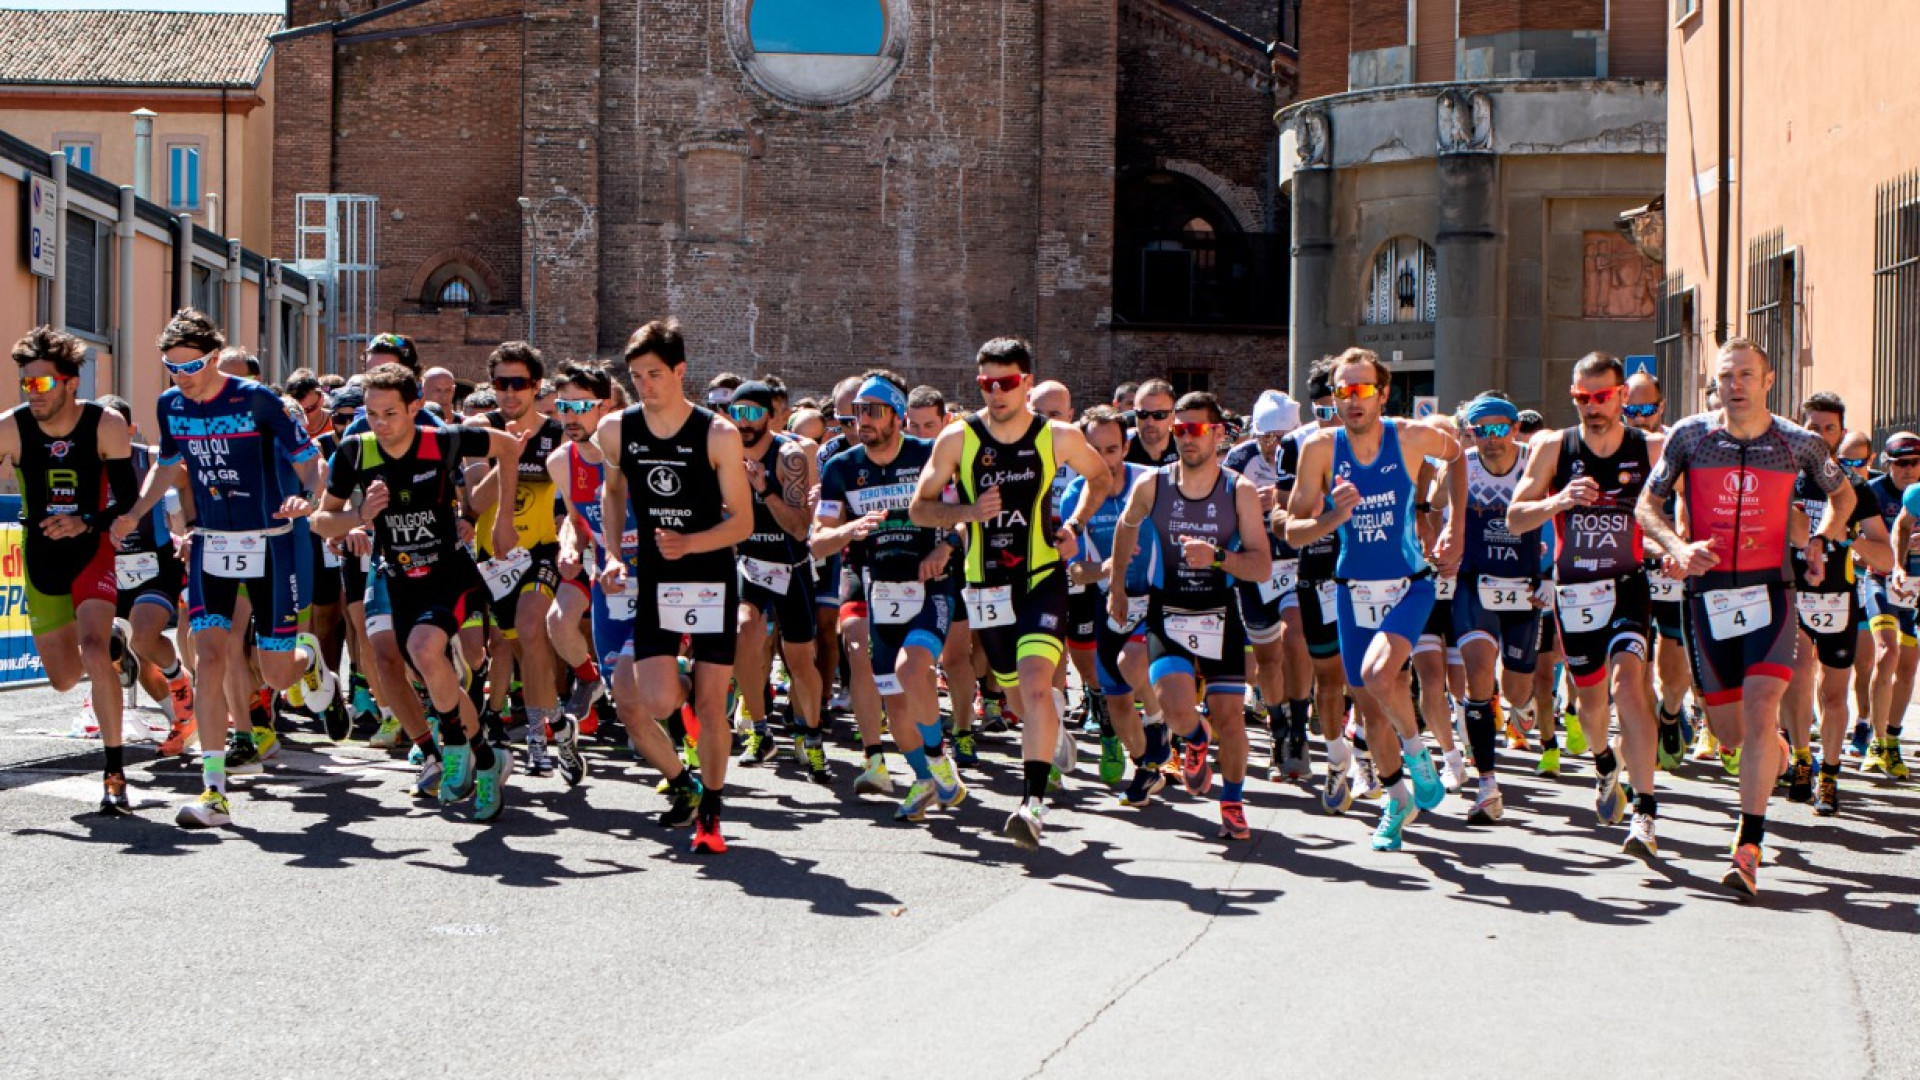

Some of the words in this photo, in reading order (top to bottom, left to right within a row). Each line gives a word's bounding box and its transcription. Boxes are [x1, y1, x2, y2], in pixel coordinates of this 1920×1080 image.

[198, 454, 226, 466] ITA
[649, 508, 692, 517] MURERO
[859, 498, 913, 513] TRIATHLO
[385, 510, 437, 528] MOLGORA
[660, 516, 684, 527] ITA
[1572, 513, 1628, 531] ROSSI
[391, 527, 436, 543] ITA
[1358, 529, 1388, 543] ITA
[1575, 532, 1619, 549] ITA
[1487, 546, 1519, 560] ITA
[222, 554, 247, 571] 15
[499, 568, 521, 589] 90
[1271, 574, 1290, 591] 46
[1492, 590, 1517, 605] 34
[685, 608, 698, 626] 6
[890, 602, 900, 618] 2
[976, 604, 998, 622] 13
[1581, 607, 1594, 625] 5
[1733, 610, 1748, 627] 4
[1810, 613, 1834, 628] 62
[1188, 634, 1199, 649] 8
